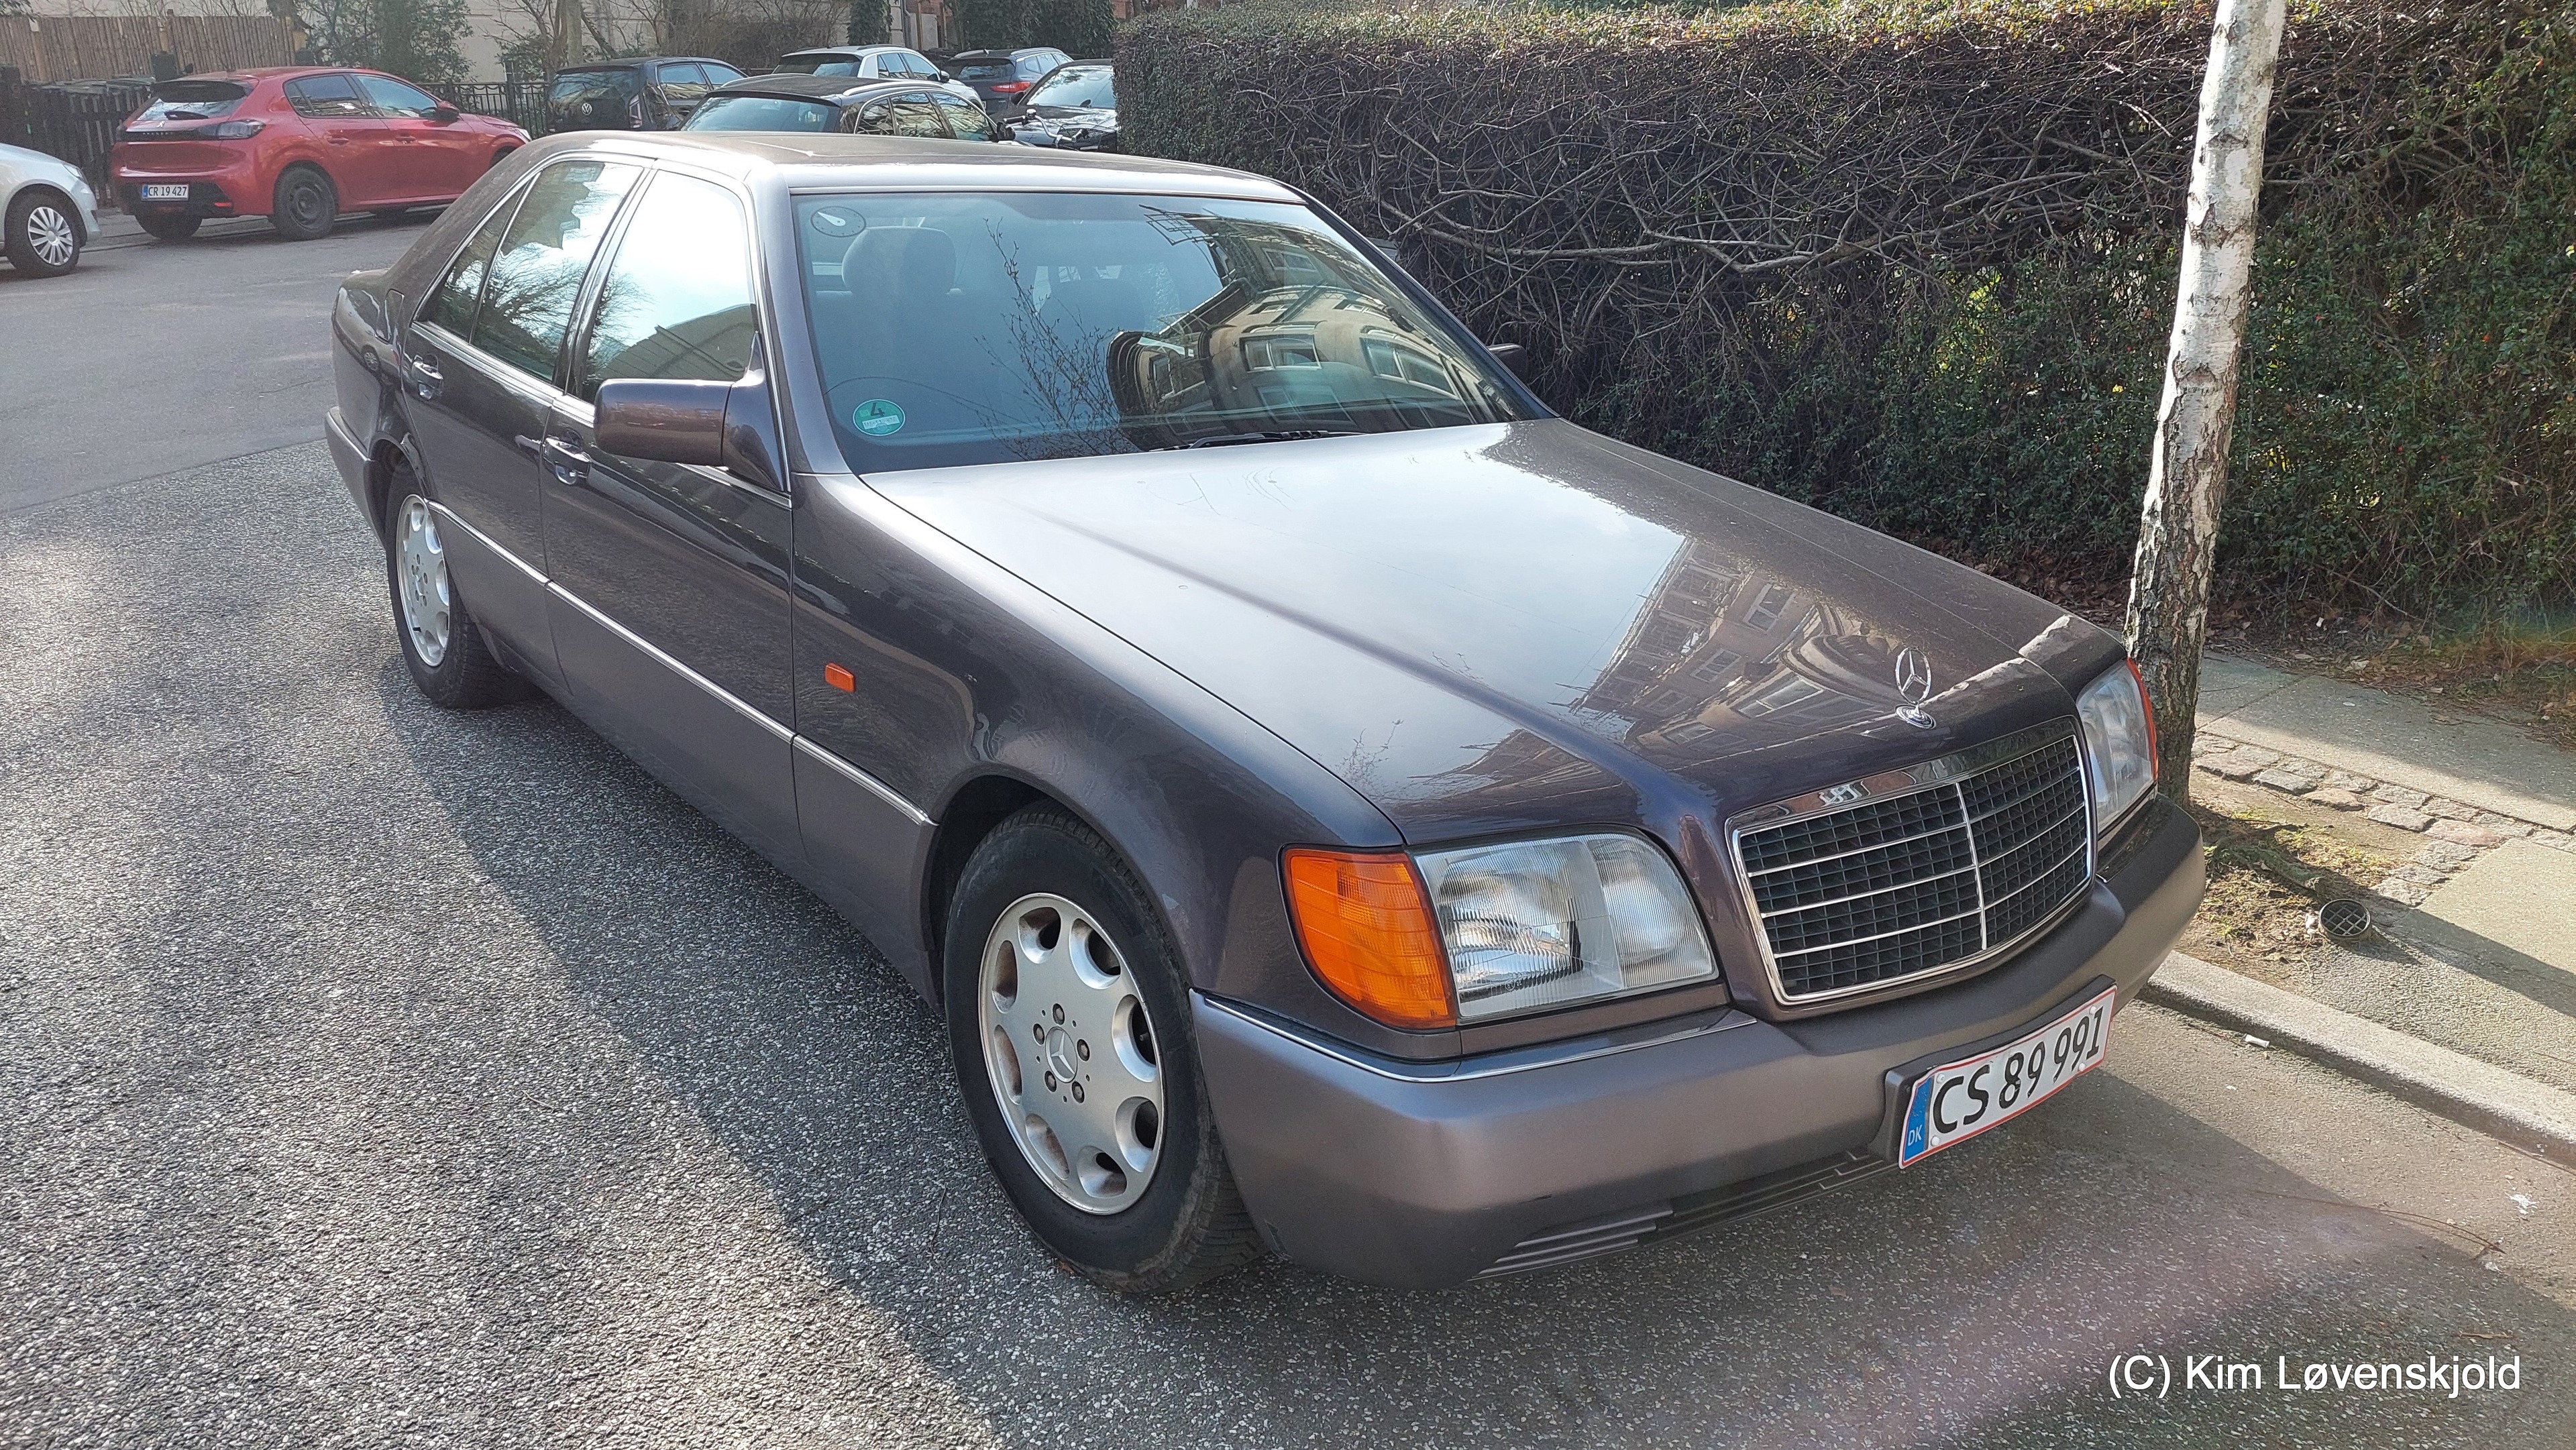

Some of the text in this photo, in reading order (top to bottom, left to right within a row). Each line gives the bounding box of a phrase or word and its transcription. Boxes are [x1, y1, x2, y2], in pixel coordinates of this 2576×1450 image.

[148, 186, 187, 197] CR 19 427
[871, 402, 885, 416] 4
[1933, 1004, 2104, 1134] CS 89 991
[1907, 1124, 1923, 1146] DK
